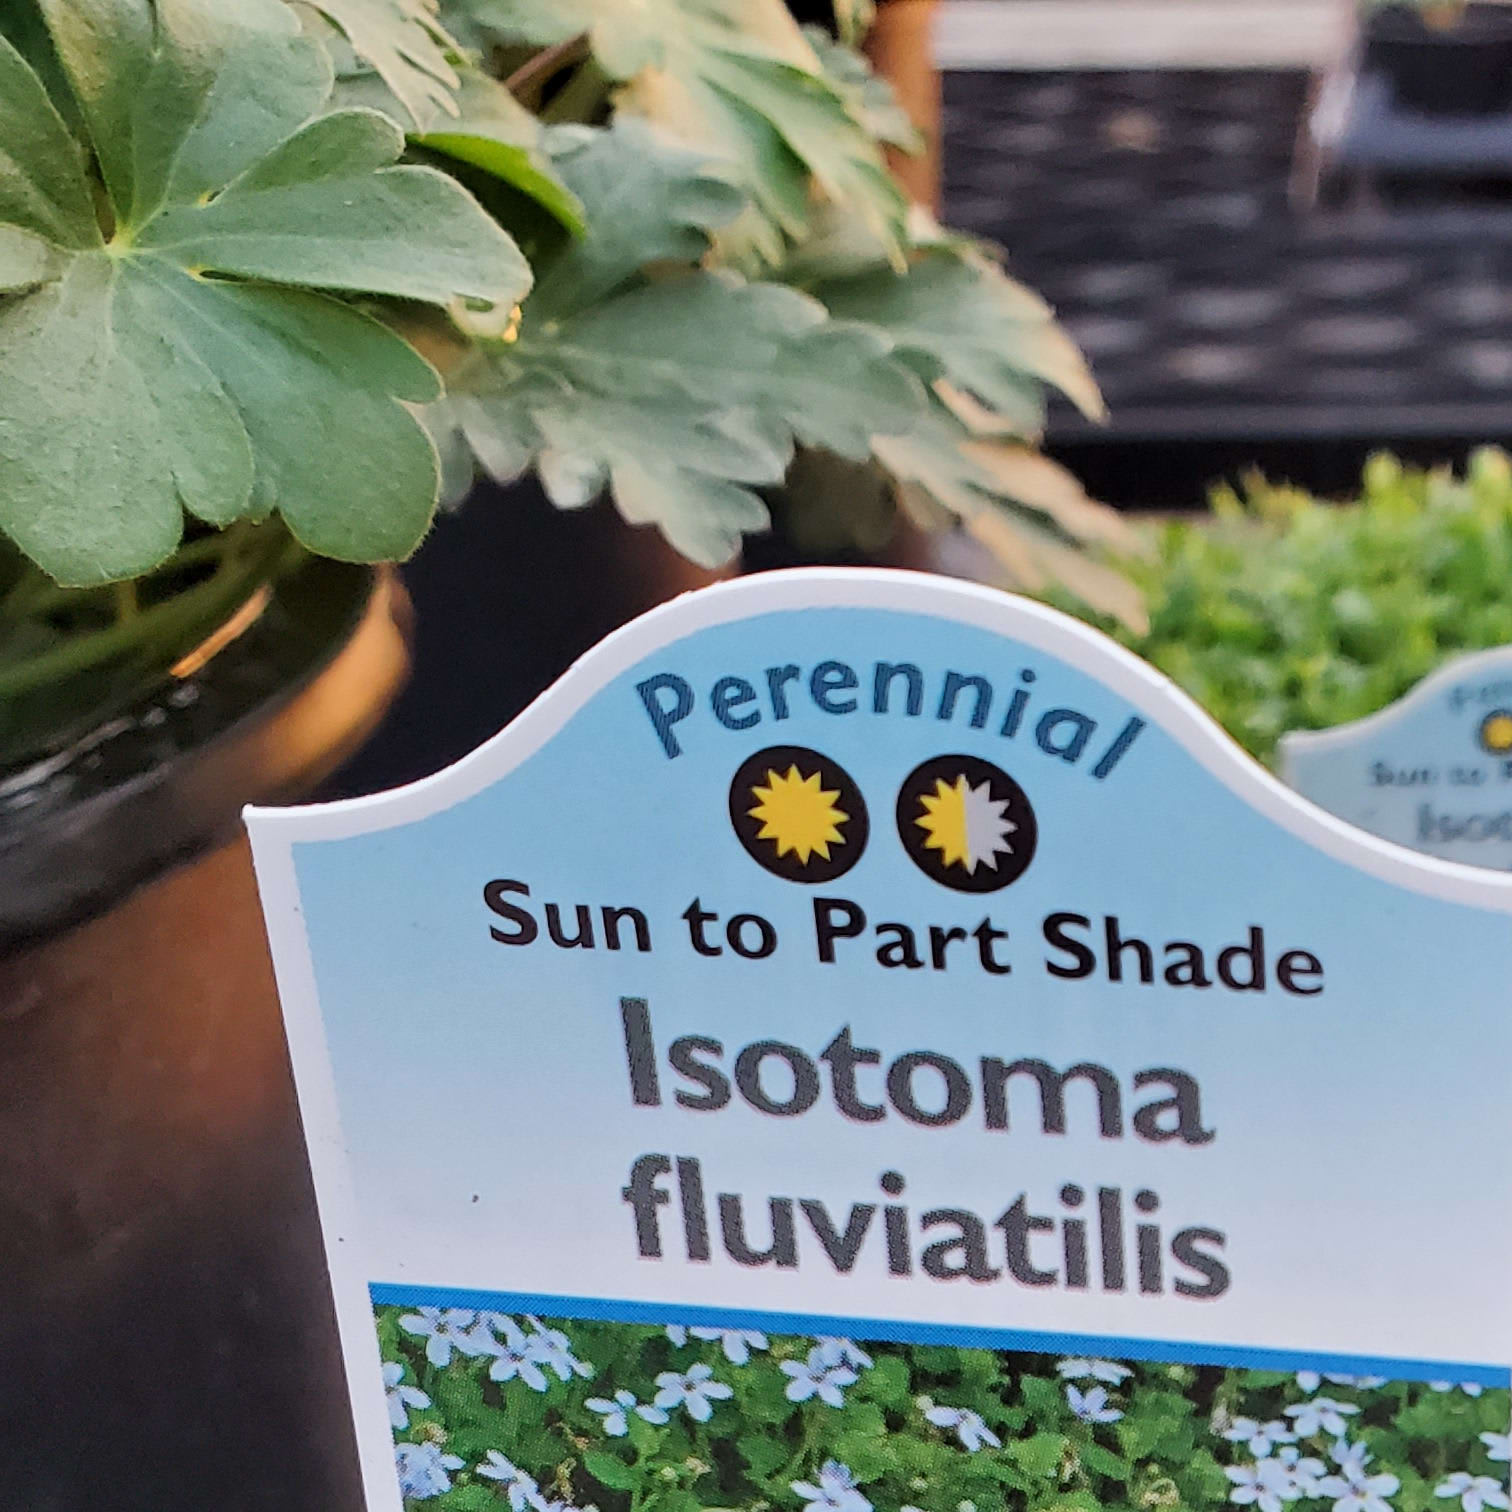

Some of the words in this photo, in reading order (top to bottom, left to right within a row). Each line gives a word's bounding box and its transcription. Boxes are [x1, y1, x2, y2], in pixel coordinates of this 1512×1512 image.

[636, 660, 1148, 781] Perennial
[483, 879, 652, 952] Sun
[683, 895, 777, 960] to
[813, 897, 1011, 975] Part
[1044, 912, 1326, 996] Shade
[619, 996, 1216, 1146] Isotoma
[622, 1152, 1231, 1302] fluviatilis
